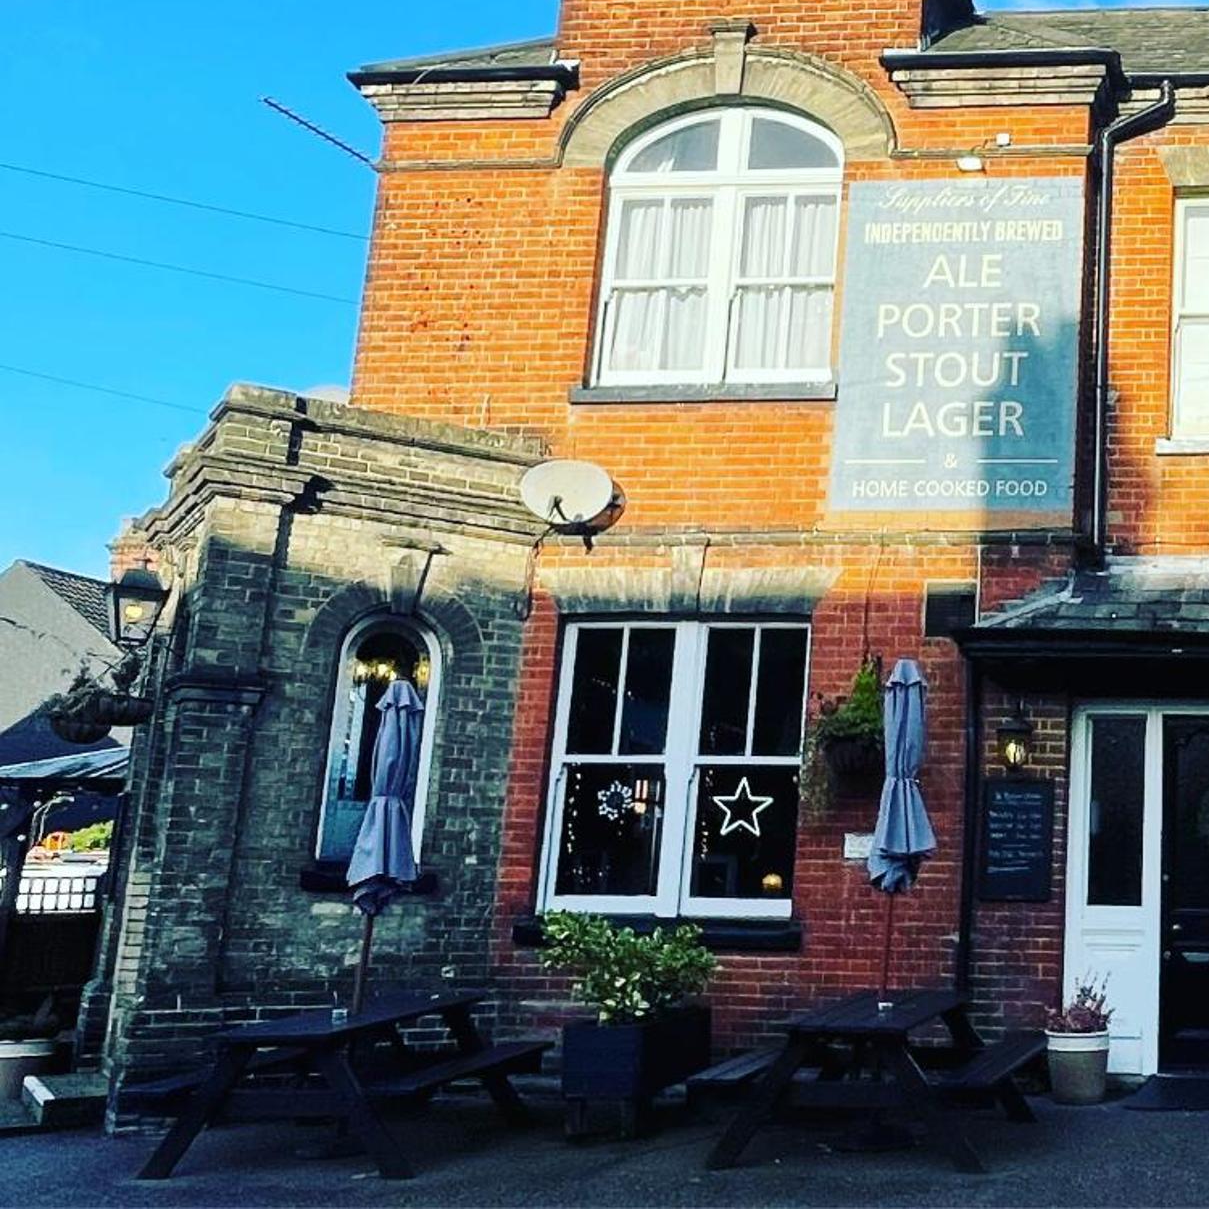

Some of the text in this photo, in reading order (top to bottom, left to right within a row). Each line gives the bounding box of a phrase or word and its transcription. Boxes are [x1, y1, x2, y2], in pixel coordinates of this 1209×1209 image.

[879, 184, 976, 215] Suppliers
[979, 187, 1006, 212] of
[864, 219, 1063, 244] INDEPENDENTLY BREWED
[923, 253, 1003, 289] ALE
[876, 302, 1041, 339] PORTER
[885, 350, 1029, 388] STOUT
[881, 399, 1024, 438] LAGER
[943, 453, 958, 469] &
[852, 478, 1048, 498] HOME COOKED FOOD
